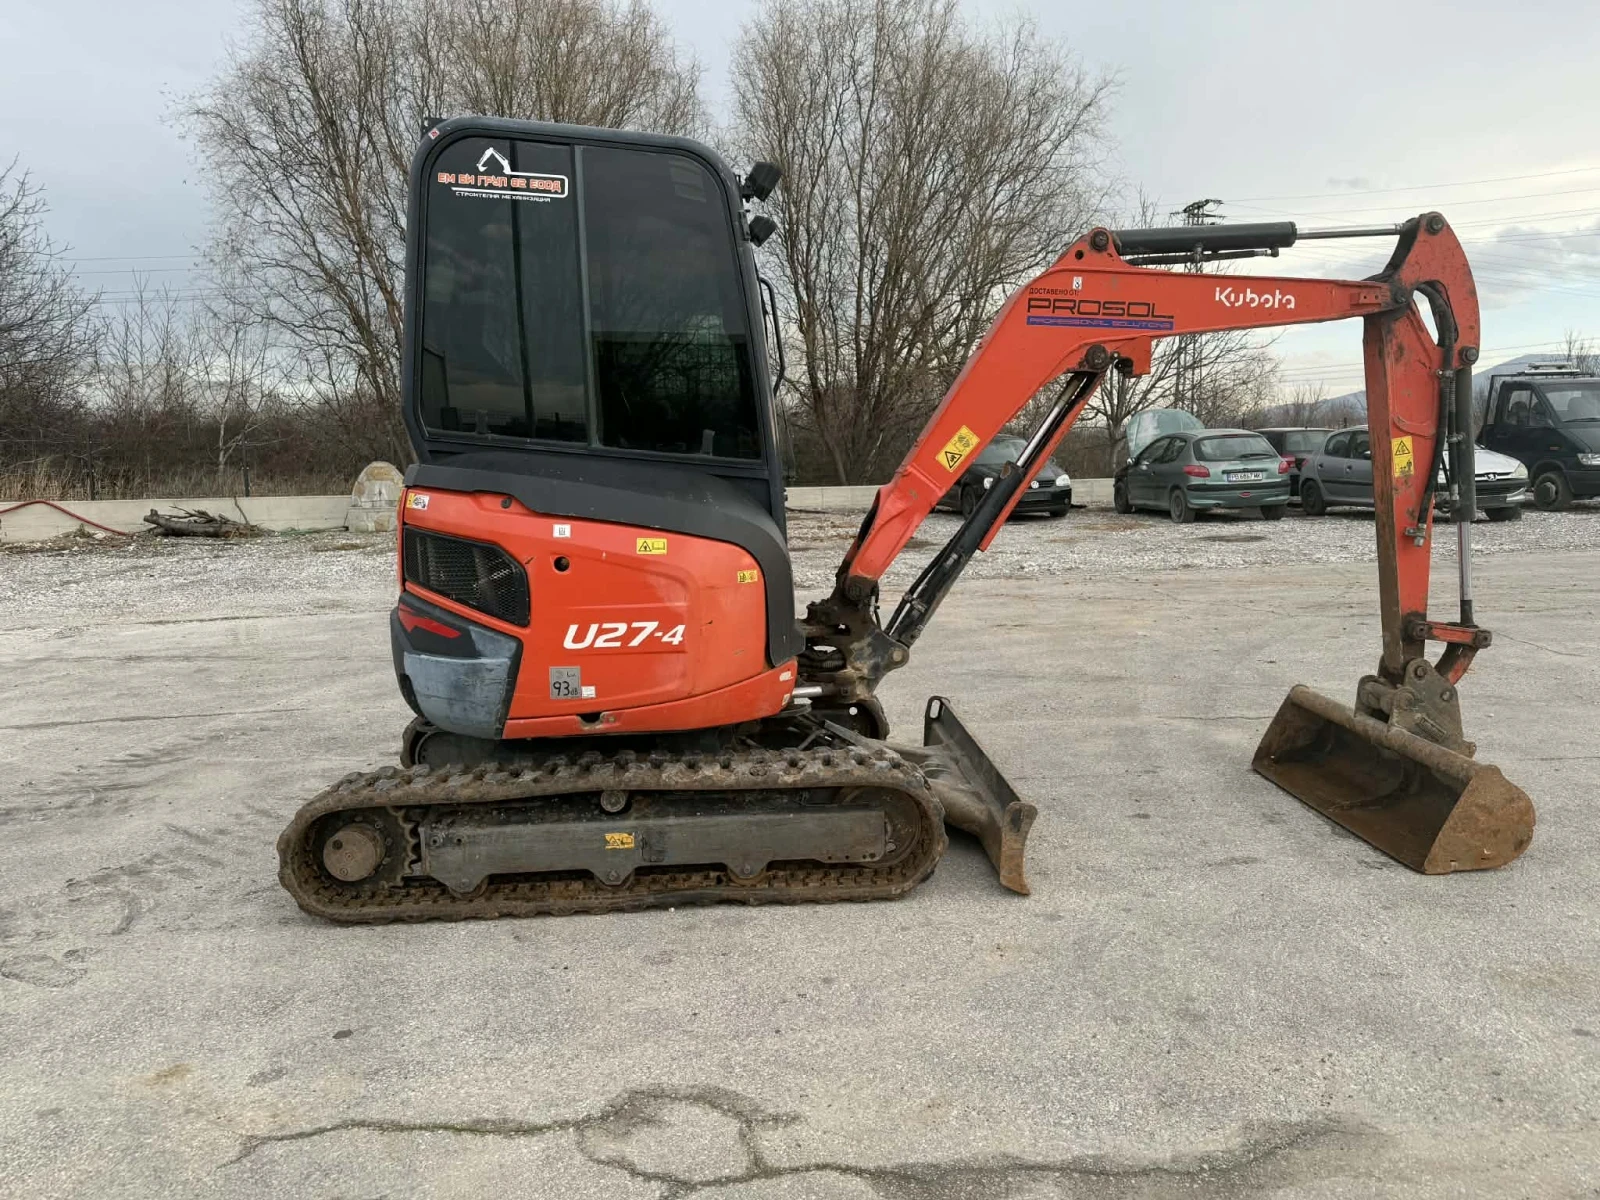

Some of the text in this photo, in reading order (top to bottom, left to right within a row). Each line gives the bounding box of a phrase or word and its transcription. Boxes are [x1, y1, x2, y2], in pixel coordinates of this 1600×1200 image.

[437, 172, 456, 184] ЕМ
[458, 173, 475, 185] БИ
[477, 175, 508, 188] ГРУП
[529, 178, 562, 193] ЕООД
[1028, 287, 1068, 296] ДОСТАВЕНО
[1215, 287, 1295, 309] Kubota
[1027, 297, 1174, 319] PROSOL
[563, 621, 686, 649] U27-4
[552, 680, 570, 697] 93
